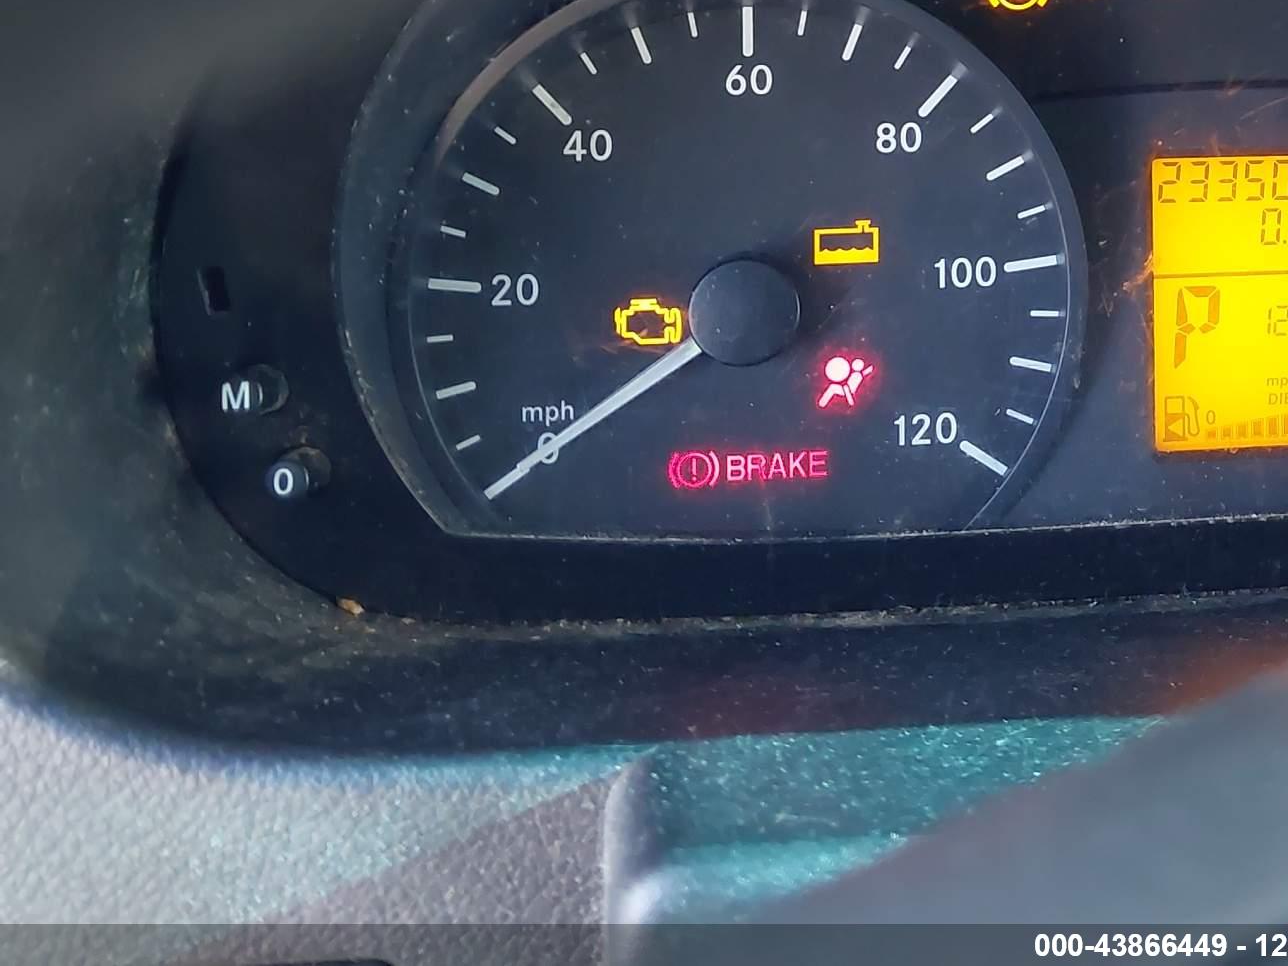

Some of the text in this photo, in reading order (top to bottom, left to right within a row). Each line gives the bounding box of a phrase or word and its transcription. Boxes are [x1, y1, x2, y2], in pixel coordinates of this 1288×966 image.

[724, 65, 774, 96] 60
[563, 130, 613, 162] 40
[875, 122, 922, 153] 80
[933, 257, 998, 288] 100
[490, 274, 539, 306] 20
[221, 381, 250, 411] M
[520, 401, 574, 424] mph
[1206, 410, 1216, 424] 0
[893, 413, 958, 445] 120
[272, 468, 294, 495] 0
[726, 450, 828, 483] BRAKE
